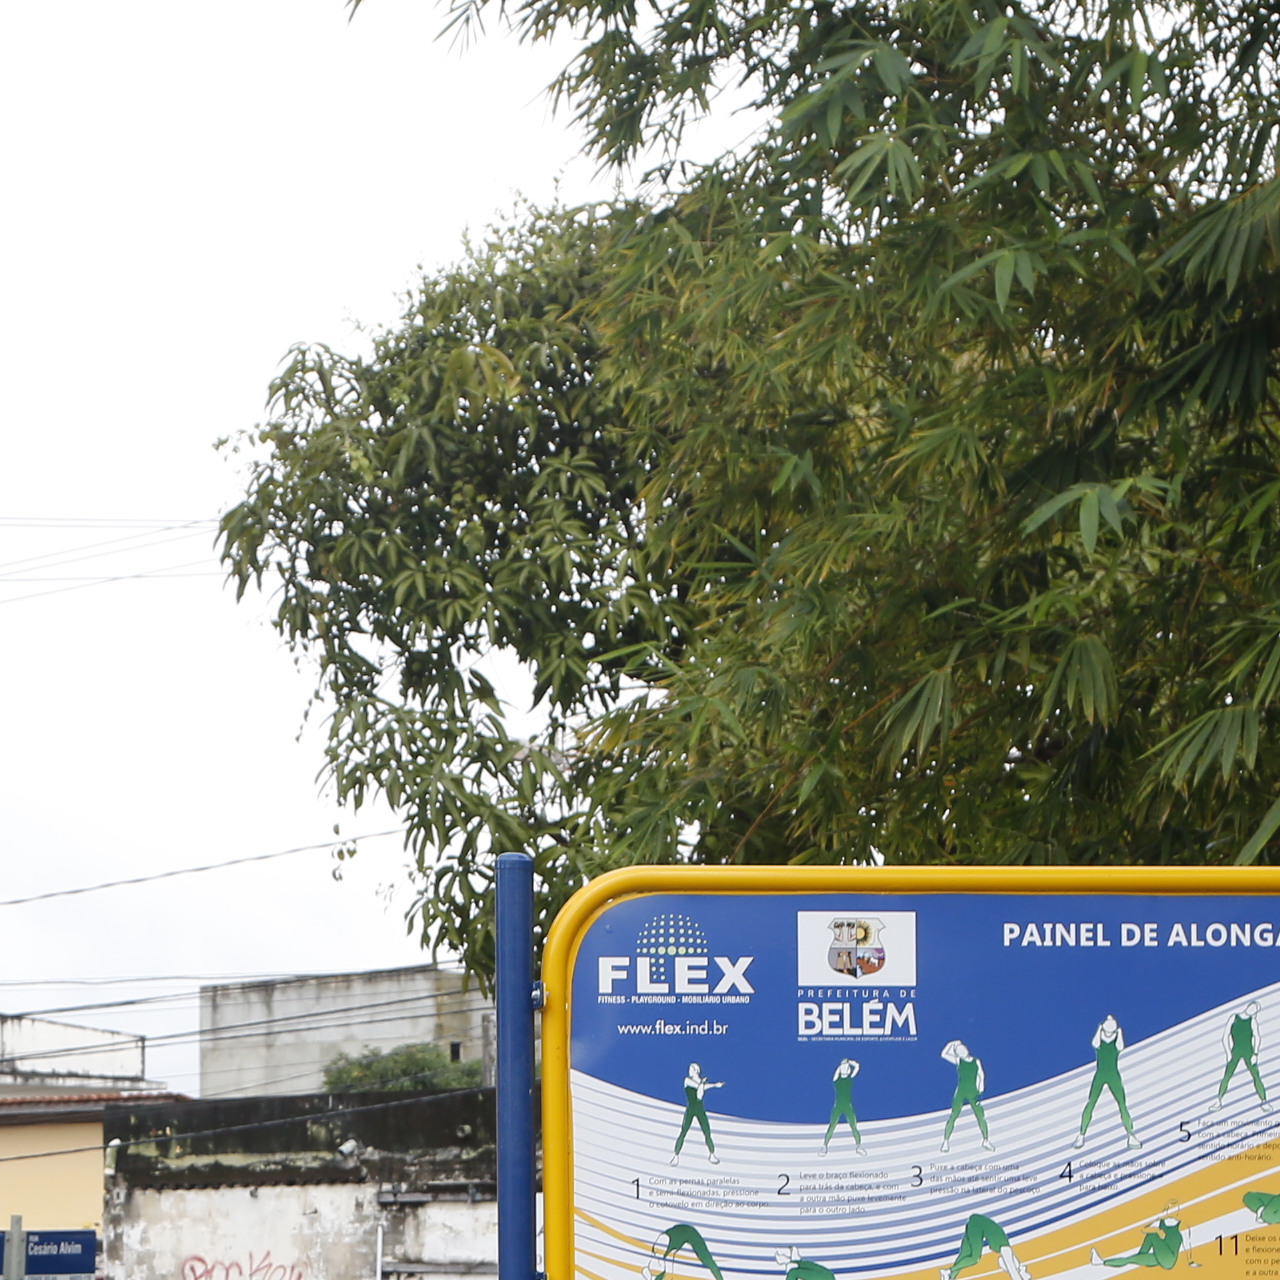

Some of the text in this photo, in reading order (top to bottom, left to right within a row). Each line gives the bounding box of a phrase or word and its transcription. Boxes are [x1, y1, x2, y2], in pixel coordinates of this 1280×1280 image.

[1004, 923, 1111, 947] PAINEL
[1121, 923, 1158, 947] DE
[599, 957, 755, 993] FLEX
[798, 990, 916, 998] PREFEITURA DE
[617, 1020, 728, 1035] www.flex.ind.br
[798, 999, 917, 1035] BELÉM
[1179, 1122, 1191, 1142] 5
[911, 1165, 923, 1187] 3
[1060, 1161, 1073, 1183] 4
[632, 1178, 640, 1199] 1
[777, 1174, 791, 1195] 2
[28, 1242, 82, 1255] Cesário Alvim
[1215, 1234, 1238, 1256] 11
